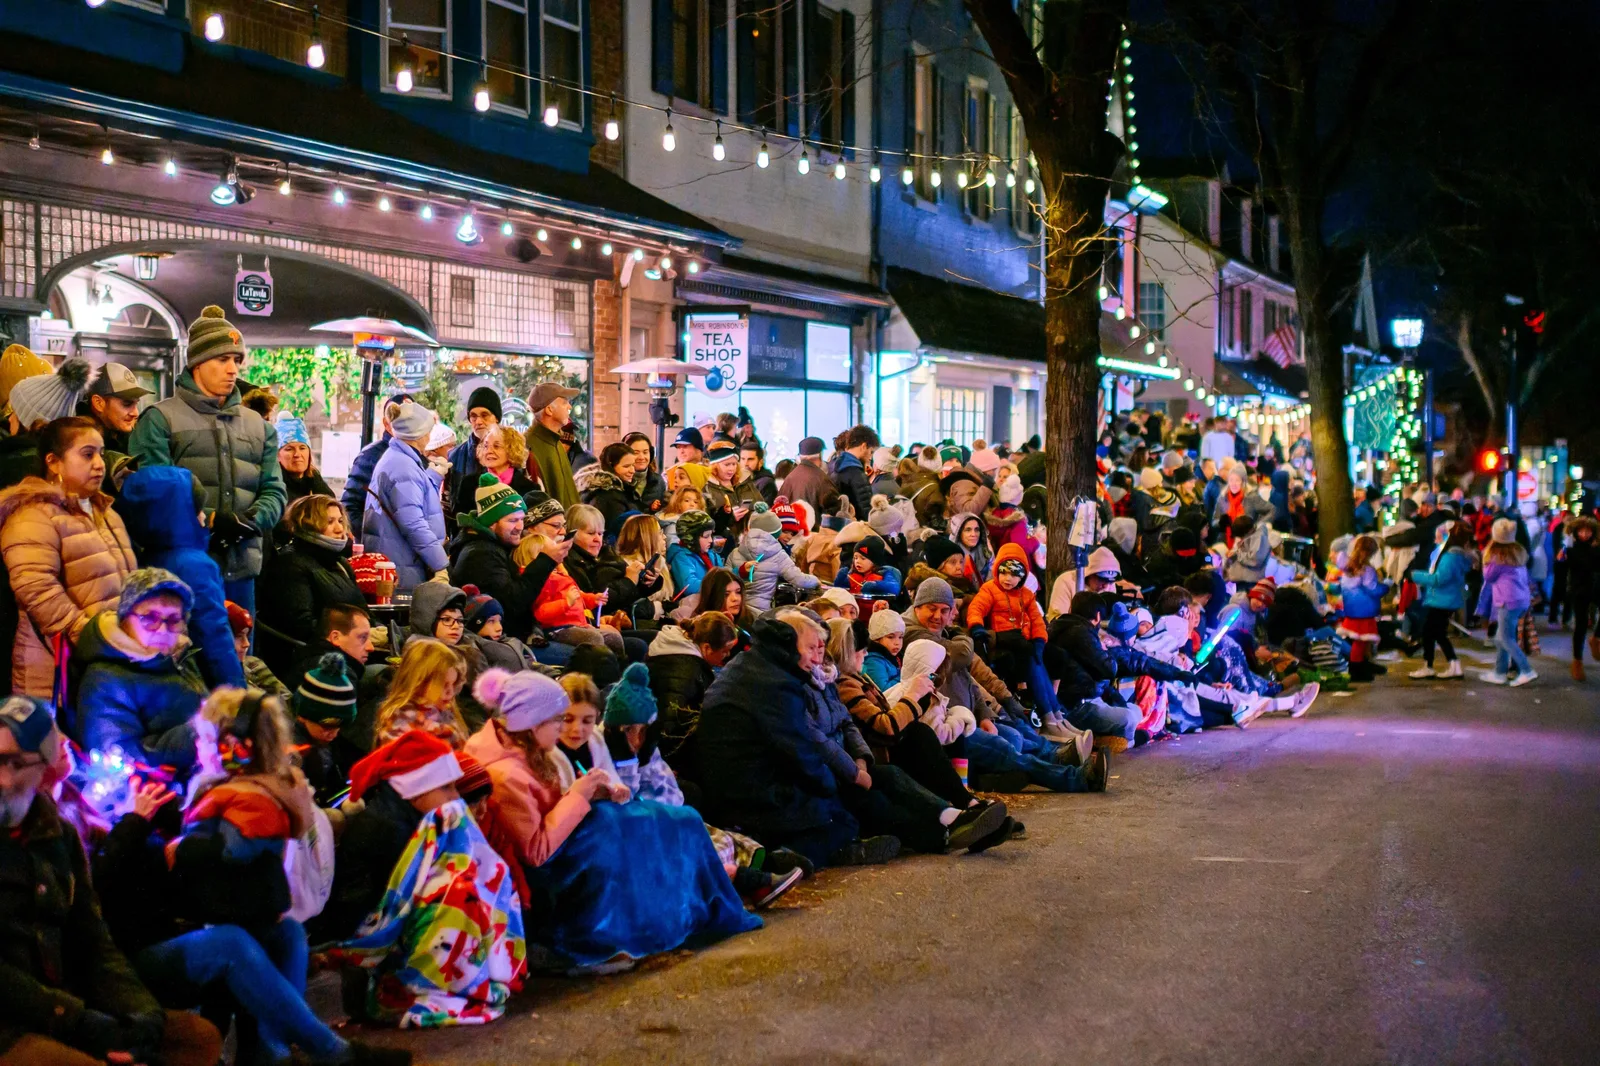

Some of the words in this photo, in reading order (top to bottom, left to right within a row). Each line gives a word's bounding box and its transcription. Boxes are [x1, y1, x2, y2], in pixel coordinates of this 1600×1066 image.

[708, 322, 744, 330] ROBINSON'S
[703, 333, 734, 346] TEA
[695, 348, 741, 362] SHOP
[762, 360, 772, 370] TEA
[774, 361, 787, 371] SHOP
